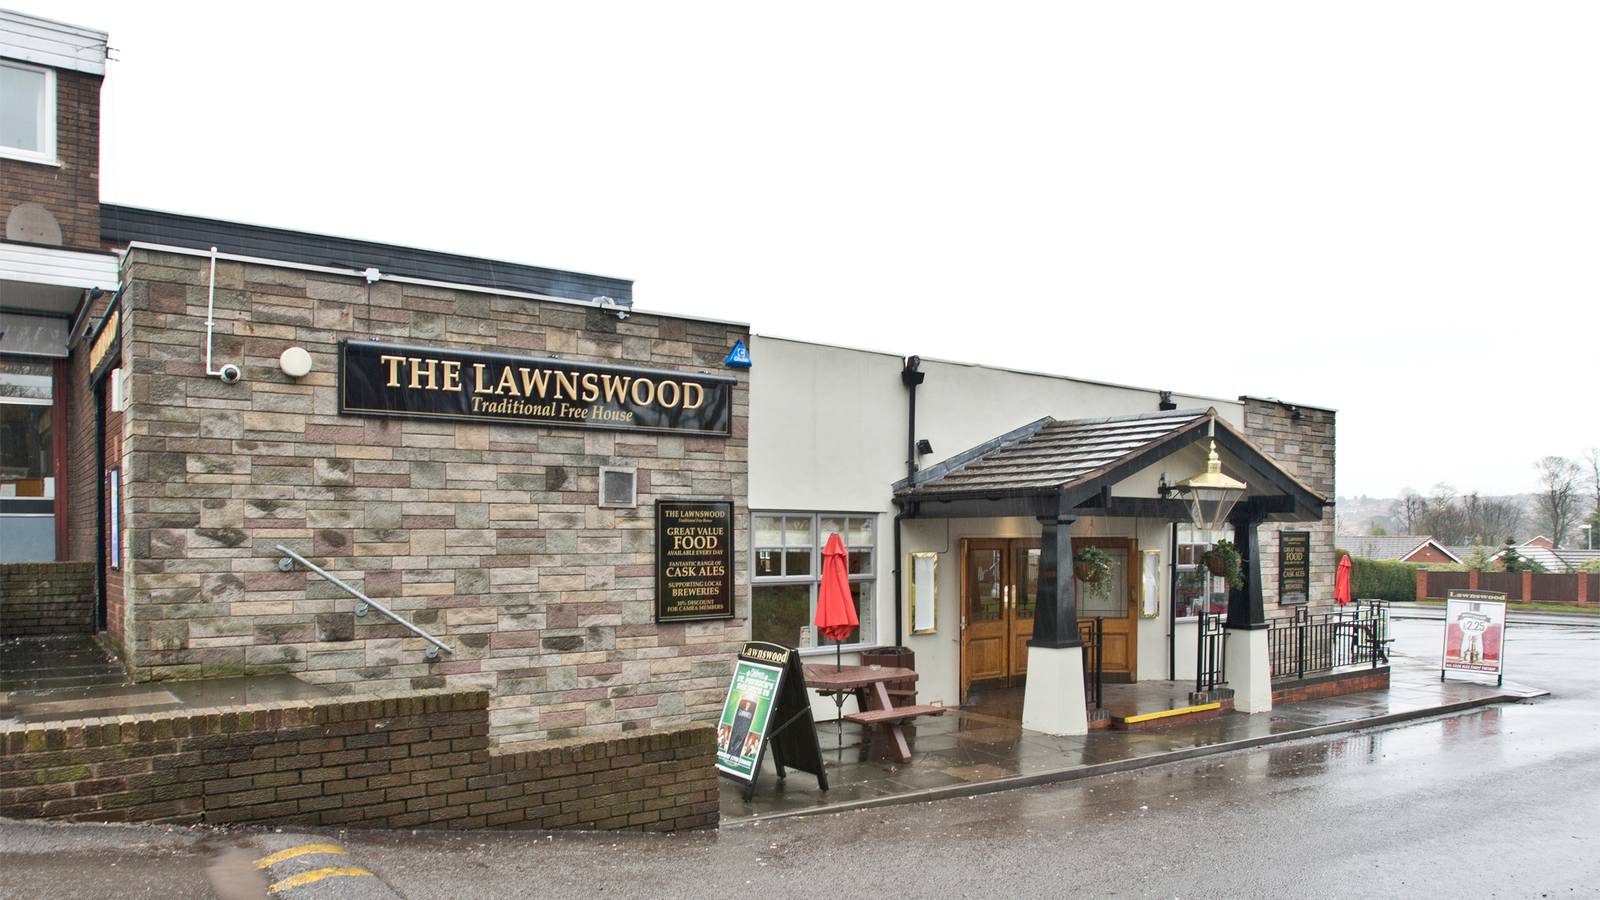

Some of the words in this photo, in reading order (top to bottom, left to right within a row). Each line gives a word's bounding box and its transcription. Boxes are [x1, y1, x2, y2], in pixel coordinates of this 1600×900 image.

[380, 354, 463, 391] THE
[472, 363, 705, 409] LAWNSWOOD
[471, 397, 557, 417] Traditional
[560, 404, 588, 420] Free
[592, 406, 633, 422] House
[665, 510, 679, 518] THE
[680, 510, 725, 518] LAWNSWOOD
[674, 536, 717, 549] FOOD
[1286, 552, 1303, 561] FOOD
[666, 567, 696, 577] CASK
[698, 566, 725, 576] ALES
[672, 587, 720, 597] BREWERIES
[1450, 591, 1505, 600] Lawnswood
[741, 644, 788, 663] Lawnswood
